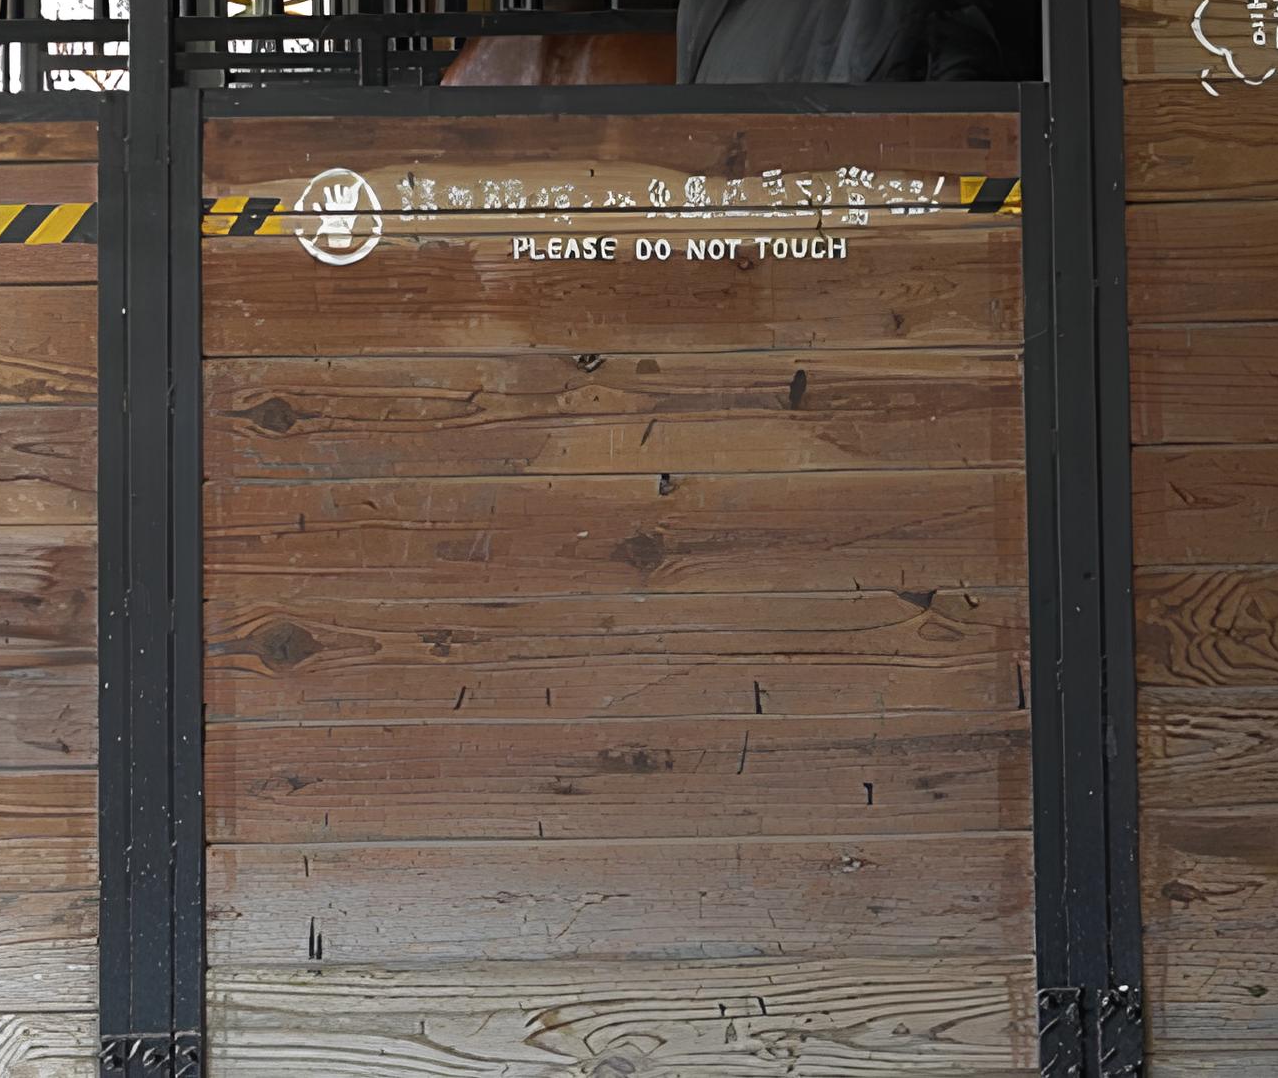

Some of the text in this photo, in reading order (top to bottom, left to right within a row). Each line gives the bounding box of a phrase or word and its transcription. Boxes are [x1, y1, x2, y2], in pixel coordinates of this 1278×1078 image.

[512, 236, 847, 260] PLEASE DO NOT TOUCH
